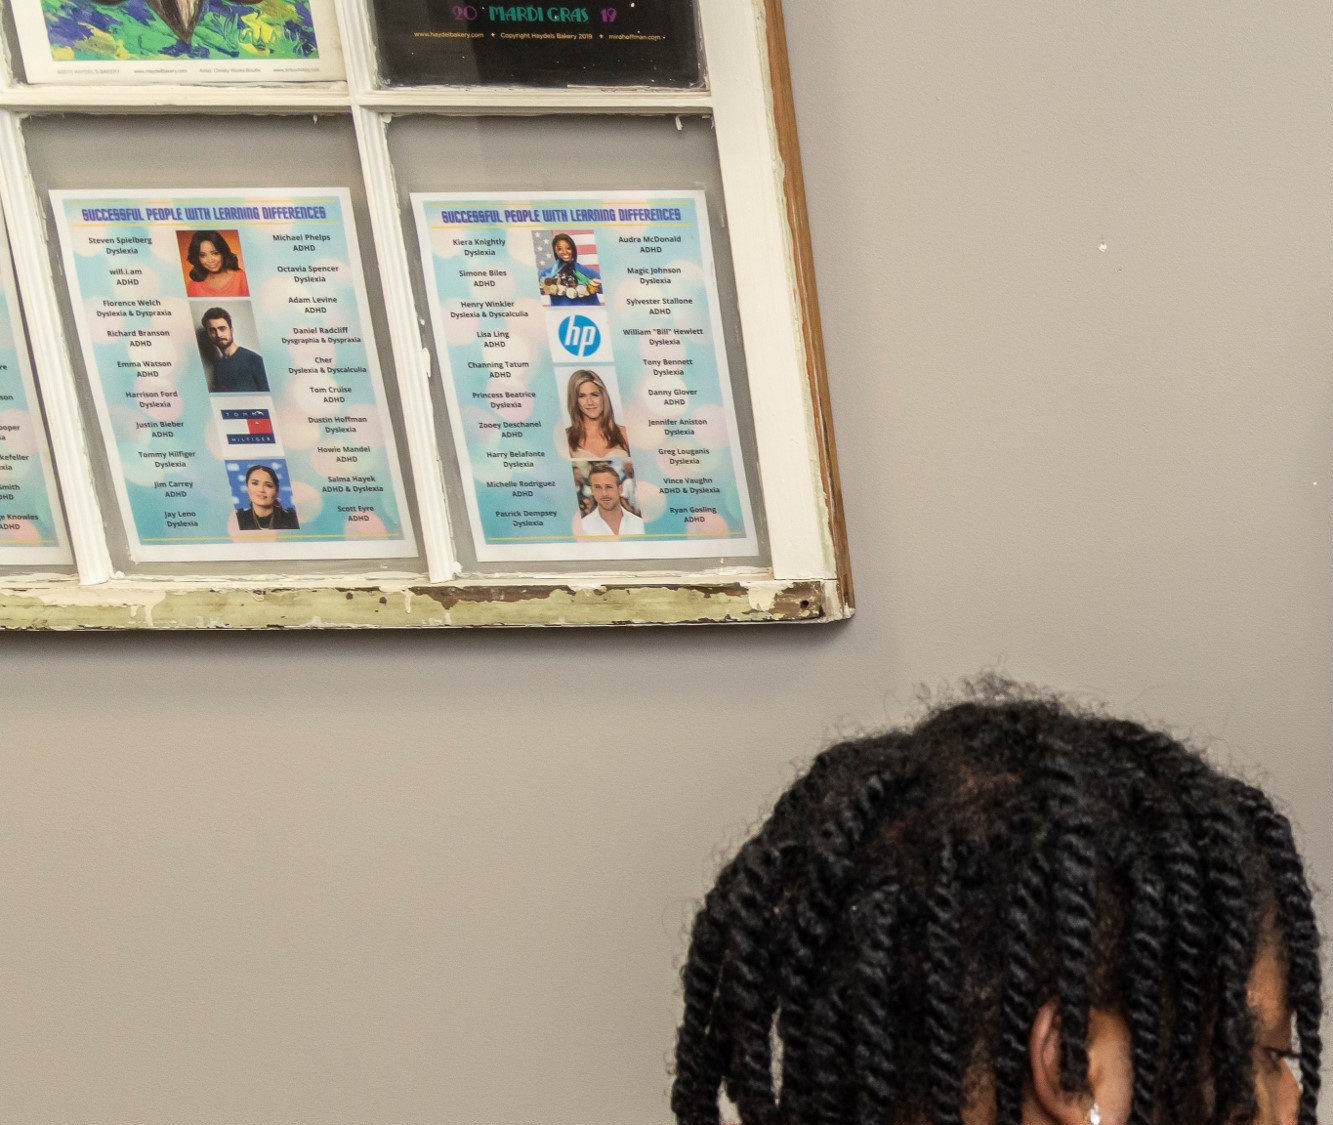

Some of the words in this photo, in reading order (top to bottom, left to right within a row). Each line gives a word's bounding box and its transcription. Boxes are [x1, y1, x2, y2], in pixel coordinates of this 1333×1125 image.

[453, 7, 478, 21] 20
[489, 6, 544, 22] MARDI
[547, 7, 589, 23] GRAS
[600, 8, 617, 23] 19
[413, 31, 484, 39] www.haydelbakery.com
[500, 32, 530, 40] Copyright
[82, 208, 144, 221] SUCCESSFUL
[145, 208, 184, 221] PEOPLE
[185, 207, 212, 220] WITH
[213, 207, 260, 220] LEARNING
[262, 206, 326, 220] DIFFERENCES
[441, 210, 503, 224] SUCCESSFUL
[504, 210, 541, 223] PEOPLE
[543, 209, 568, 222] WITH
[570, 209, 616, 222] LEARNING
[618, 208, 681, 221] DIFFERENCES
[116, 237, 152, 245] Spielberg
[305, 234, 331, 242] Phelps
[474, 239, 506, 247] Knightly
[464, 249, 496, 257] Dyslexia
[308, 266, 339, 274] Spencer
[294, 276, 326, 284] Dyslexia
[640, 278, 672, 286] Dyslexia
[494, 331, 510, 339] Ling
[565, 315, 596, 357] hp
